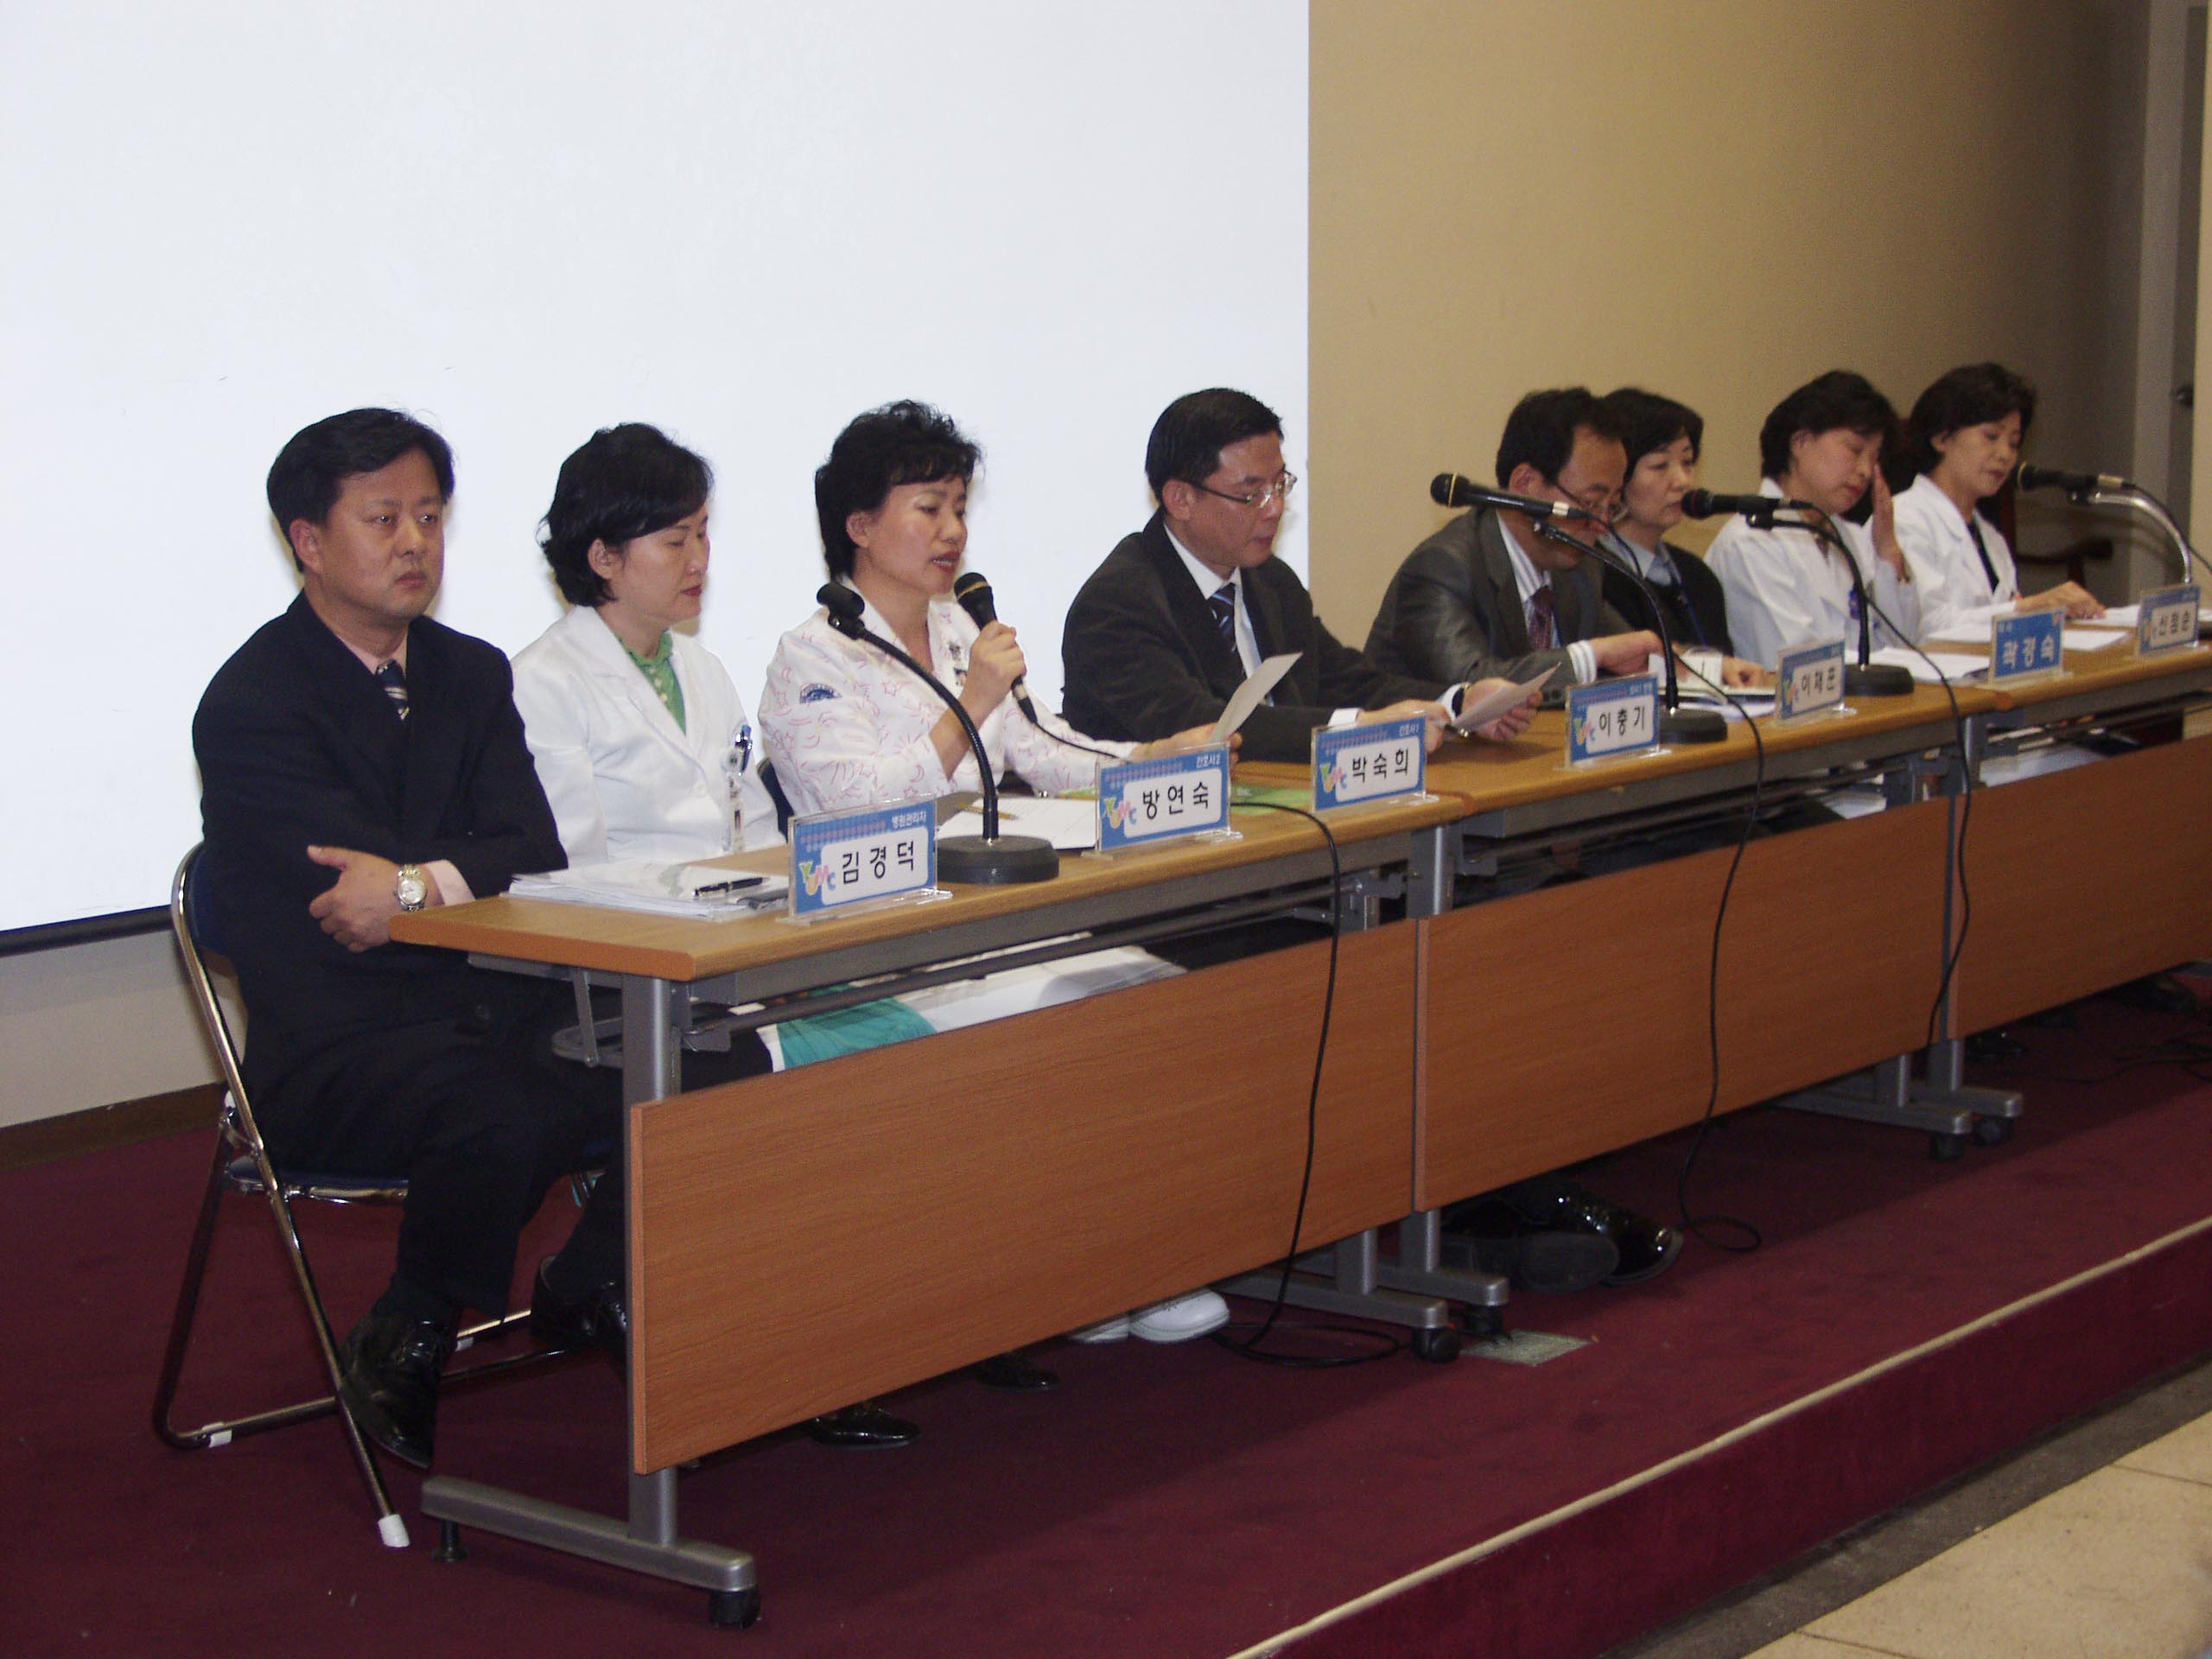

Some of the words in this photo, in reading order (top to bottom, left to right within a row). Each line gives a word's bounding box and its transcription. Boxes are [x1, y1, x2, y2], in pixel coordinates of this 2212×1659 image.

[1599, 705, 1646, 737] 이충기
[1351, 747, 1409, 783] 박숙희
[1142, 781, 1209, 820] 방연숙
[892, 810, 927, 829] 병원관리자
[842, 840, 914, 885] 김경덕
